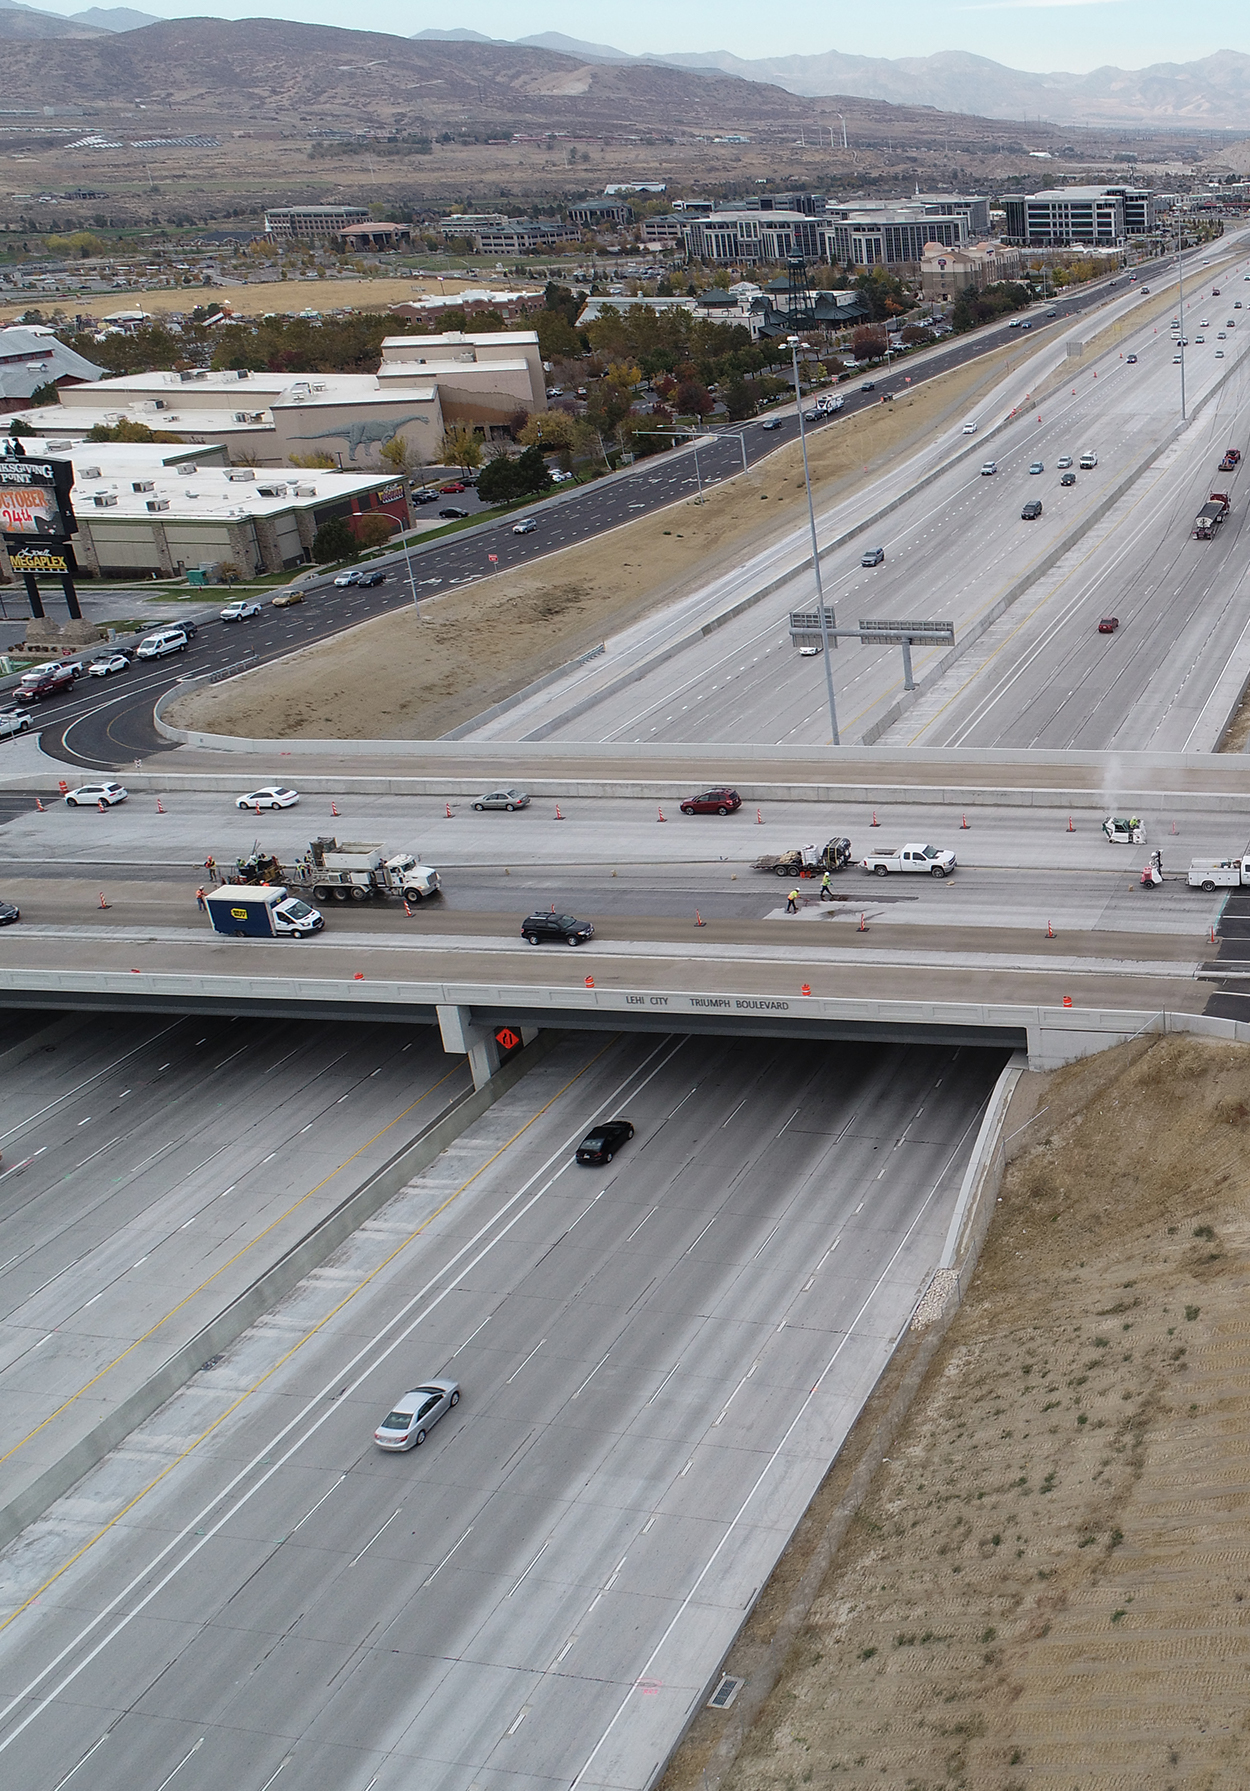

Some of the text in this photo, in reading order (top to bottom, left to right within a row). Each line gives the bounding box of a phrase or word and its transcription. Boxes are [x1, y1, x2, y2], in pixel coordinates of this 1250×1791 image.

[0, 463, 54, 478] KSGIVING
[2, 473, 32, 483] POINT
[0, 490, 48, 509] CTOBER
[2, 509, 33, 532] 24th
[10, 556, 67, 568] MEGAPLEX
[626, 996, 789, 1010] LEHI CITY TRIUMPH BOULEVARD
